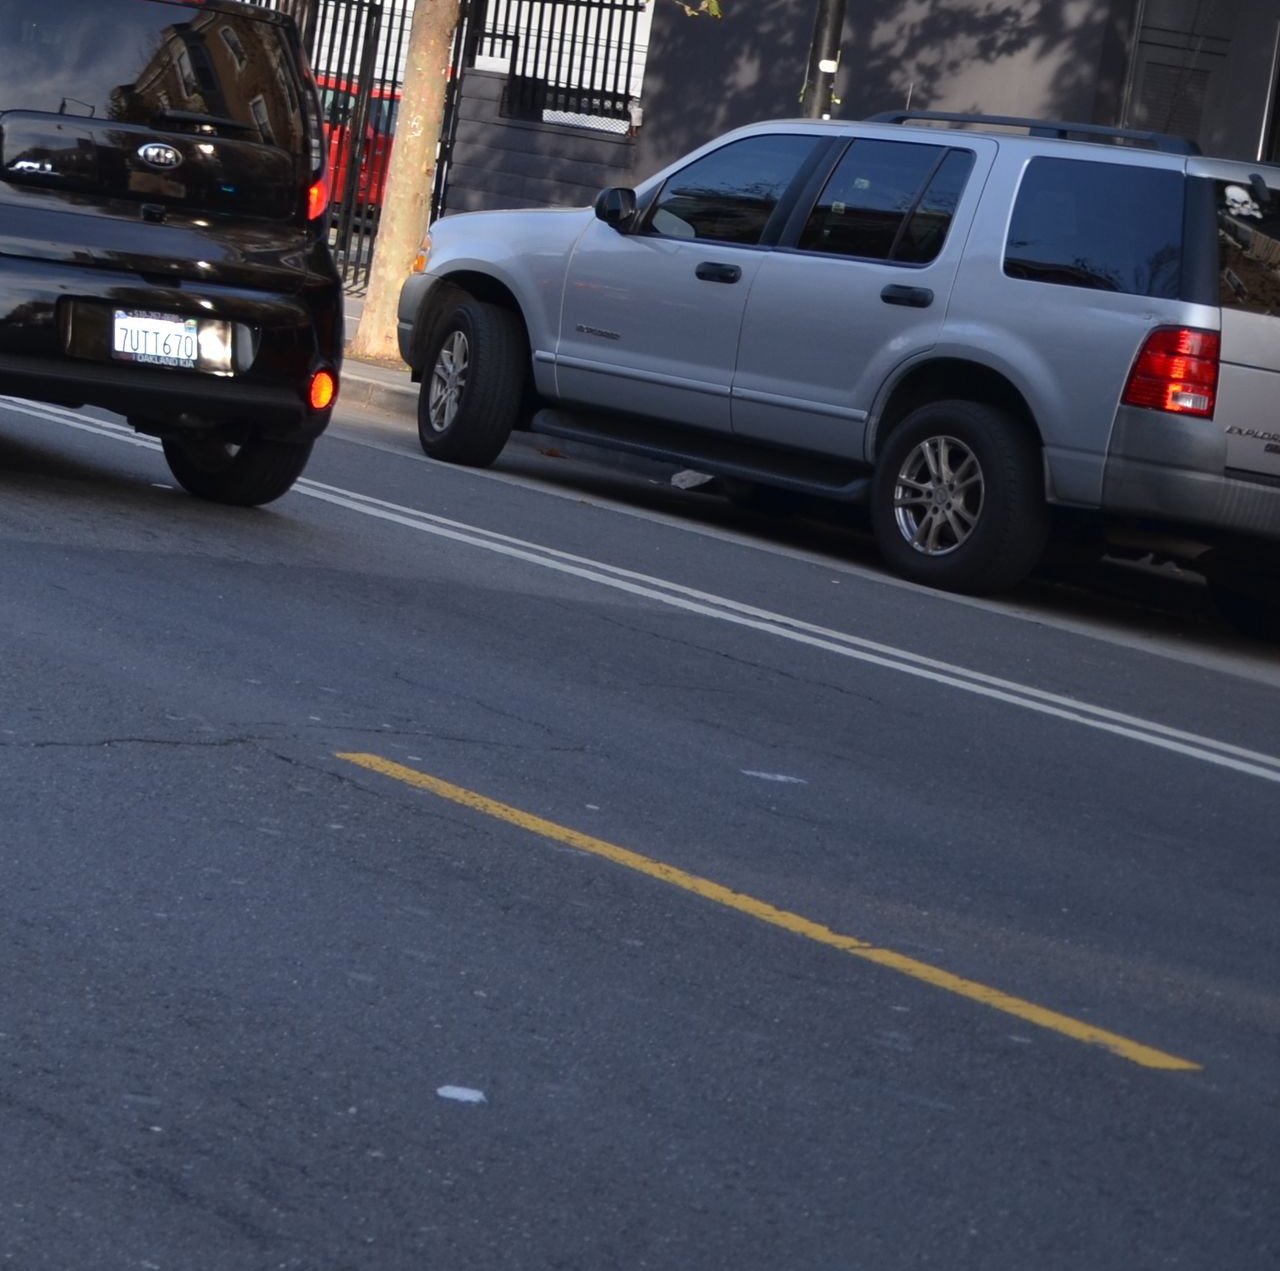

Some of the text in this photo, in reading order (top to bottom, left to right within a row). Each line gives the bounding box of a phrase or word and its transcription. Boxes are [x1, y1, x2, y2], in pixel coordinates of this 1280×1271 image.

[146, 147, 177, 165] KIA
[119, 327, 194, 358] 7UTT670
[136, 352, 195, 369] OAKLAND KIA
[1224, 424, 1280, 441] EXPLOR
